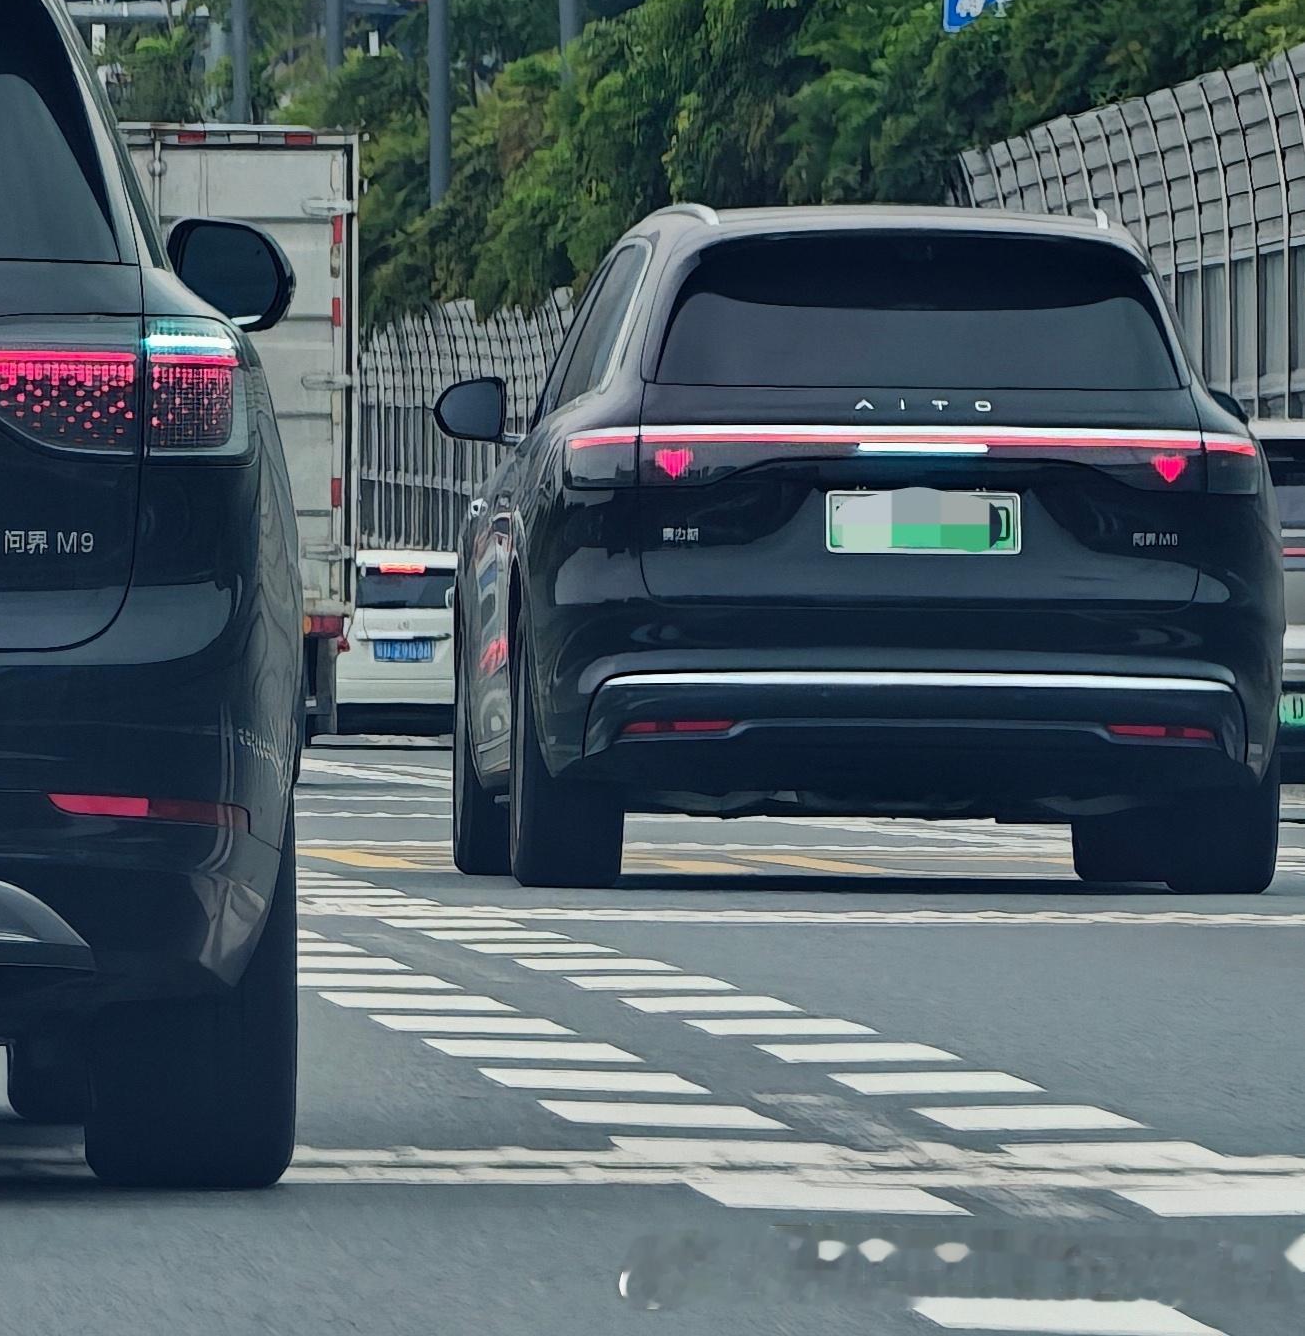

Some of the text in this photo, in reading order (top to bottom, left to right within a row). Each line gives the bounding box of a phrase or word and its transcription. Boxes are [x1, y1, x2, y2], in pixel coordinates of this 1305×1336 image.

[854, 398, 992, 412] AITO
[4, 530, 94, 554] 问界 M9
